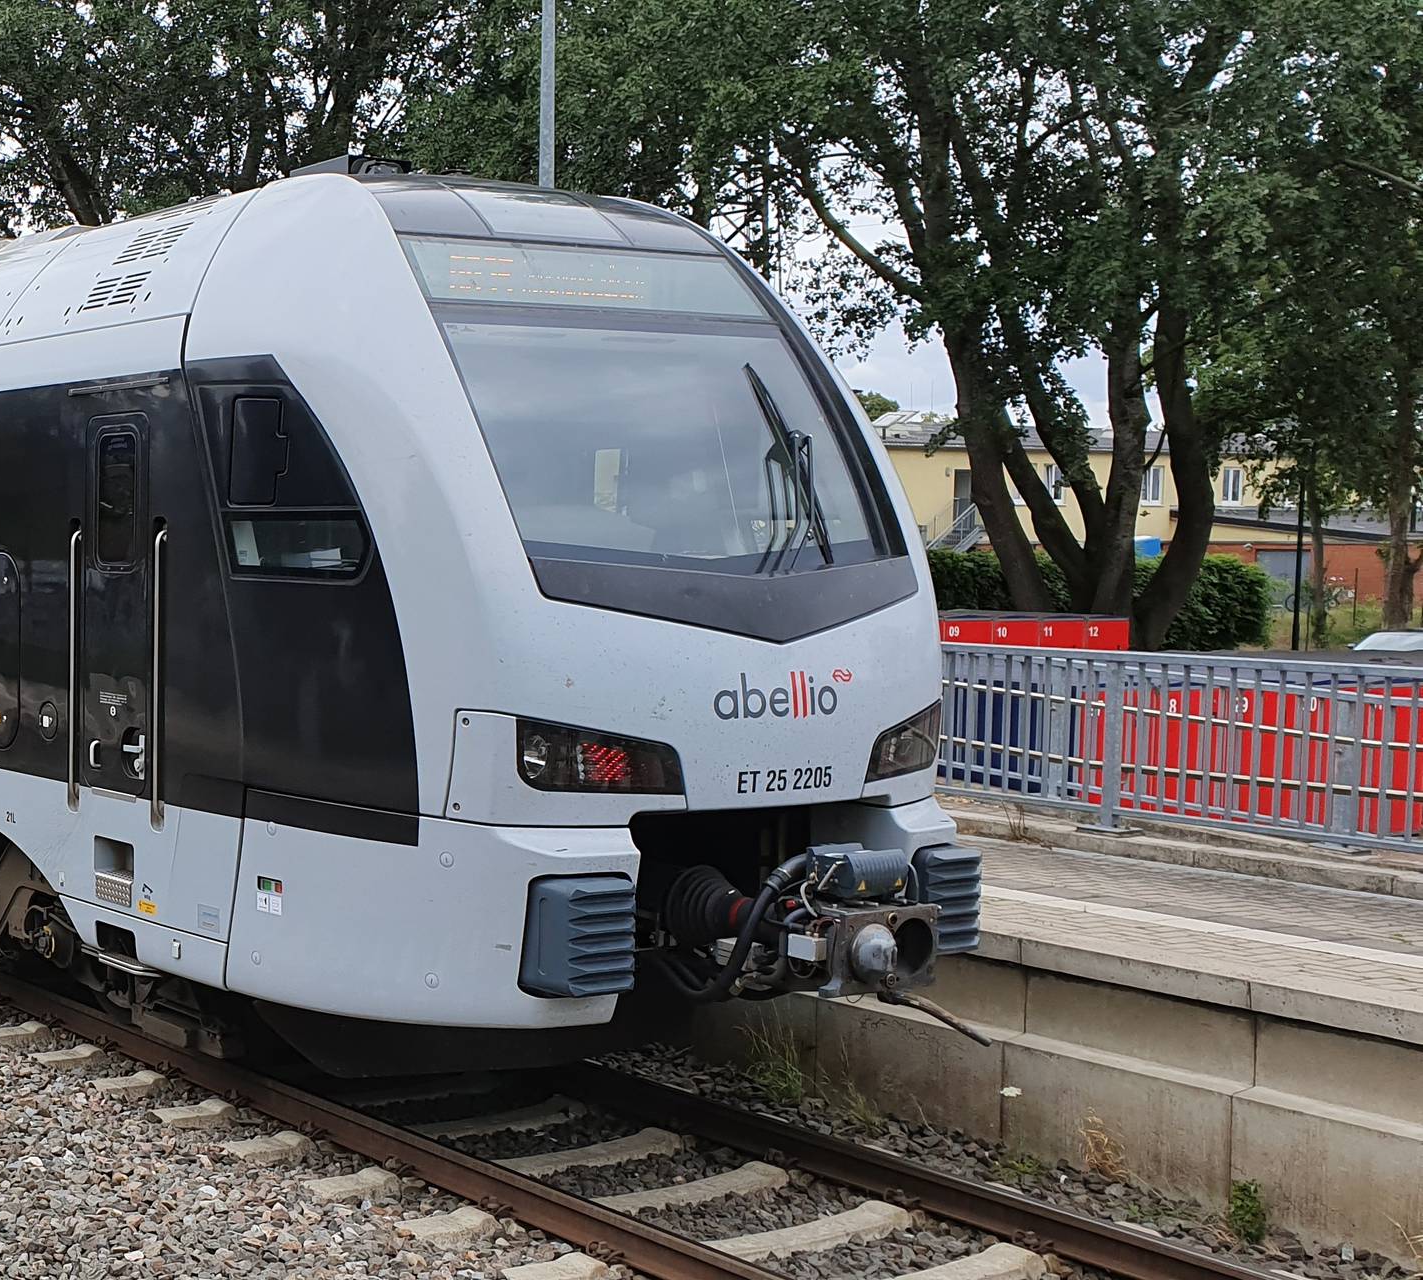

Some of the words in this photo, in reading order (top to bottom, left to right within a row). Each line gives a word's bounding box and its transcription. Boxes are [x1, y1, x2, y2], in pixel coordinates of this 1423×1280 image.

[948, 626, 960, 637] 09
[997, 626, 1007, 638] 10
[1043, 626, 1053, 636] 11
[1088, 626, 1099, 637] 12
[713, 671, 838, 720] abellio
[737, 770, 761, 794] ET
[765, 769, 787, 792] 25
[793, 766, 832, 790] 2205
[6, 811, 16, 824] 21L
